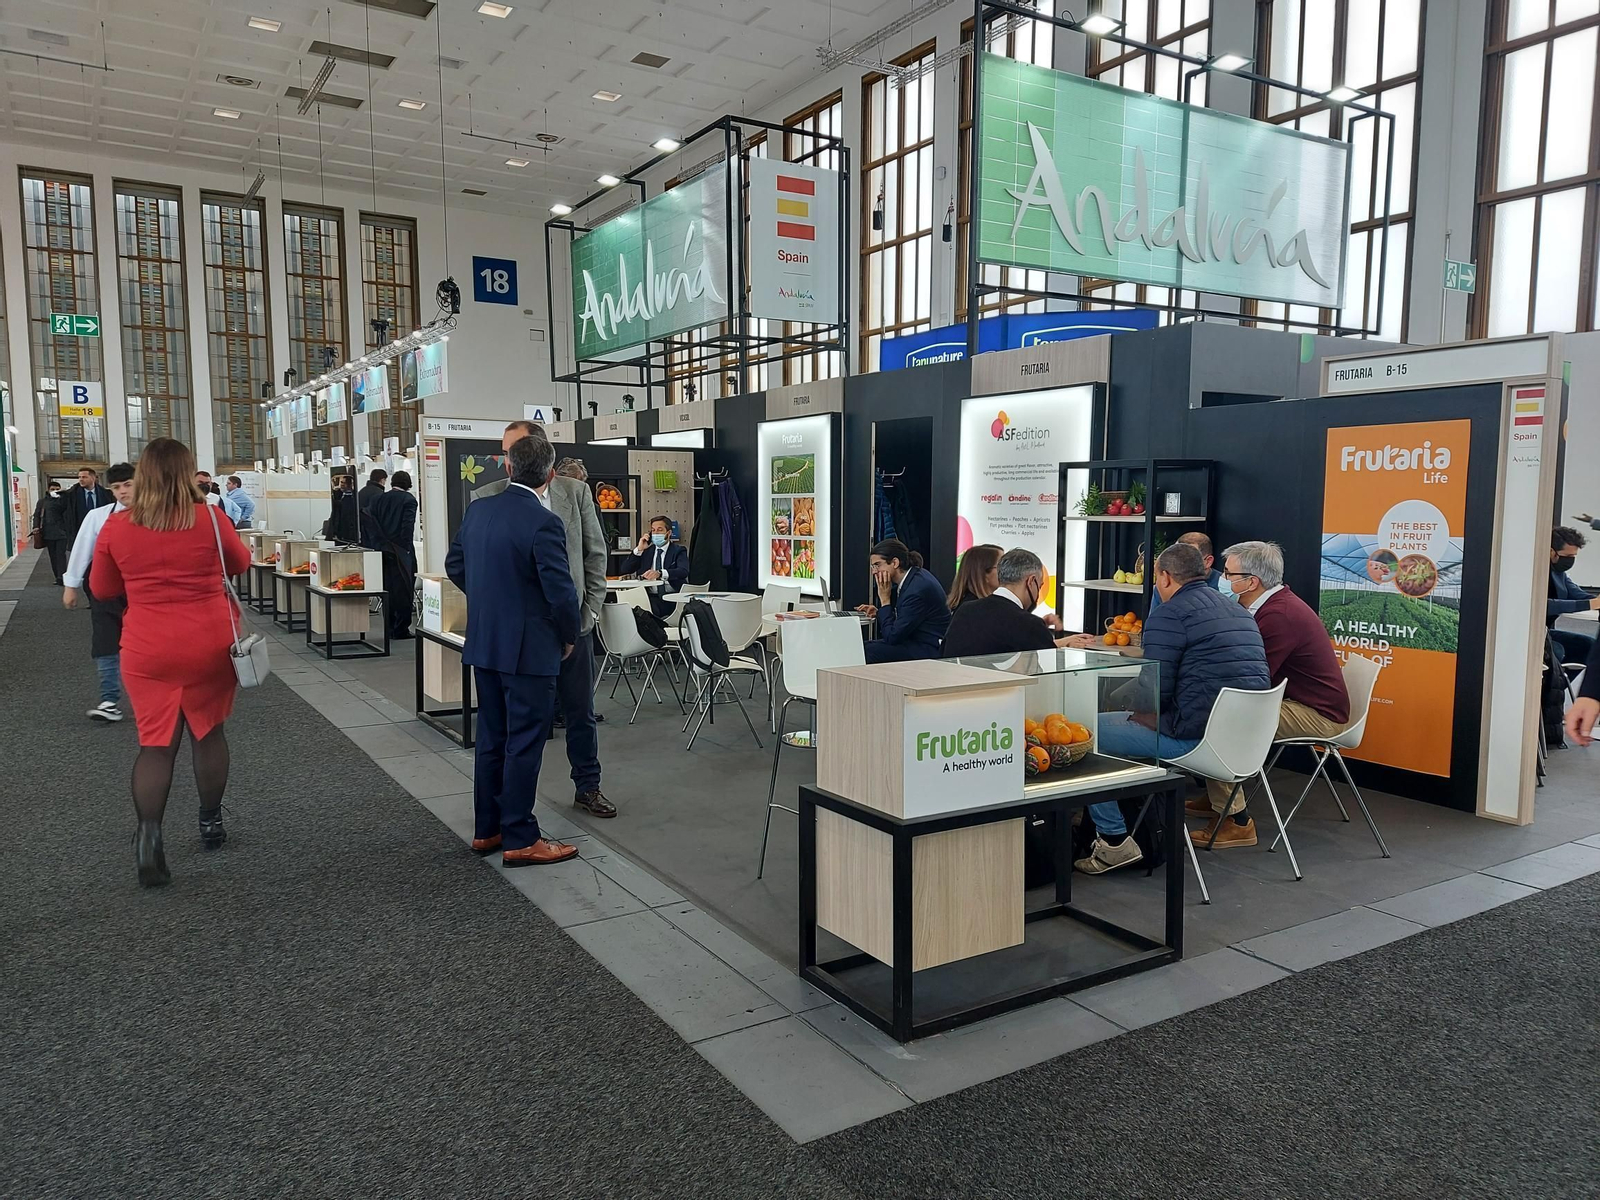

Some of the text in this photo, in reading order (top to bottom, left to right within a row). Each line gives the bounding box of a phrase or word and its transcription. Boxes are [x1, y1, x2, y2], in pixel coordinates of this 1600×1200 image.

[777, 249, 809, 264] Spain
[480, 268, 510, 294] 18
[1020, 362, 1050, 376] FRUTARIA
[1335, 363, 1408, 381] FRUTARIA B-15
[73, 385, 89, 404] B
[82, 407, 93, 415] 18
[533, 408, 546, 424] A
[997, 426, 1050, 441] ASFedition
[1513, 433, 1538, 441] Spain
[1340, 440, 1451, 471] Frutaria
[1423, 472, 1449, 484] Life
[1390, 522, 1438, 531] THE BEST
[1390, 532, 1432, 542] IN FRUIT
[1389, 542, 1428, 551] PLANTS
[1333, 619, 1418, 639] A HEALTHY
[1333, 634, 1393, 655] WORLD,
[1333, 649, 1393, 668] FU OF
[916, 721, 1014, 762] Frutaria
[942, 754, 1013, 773] A healthy world
